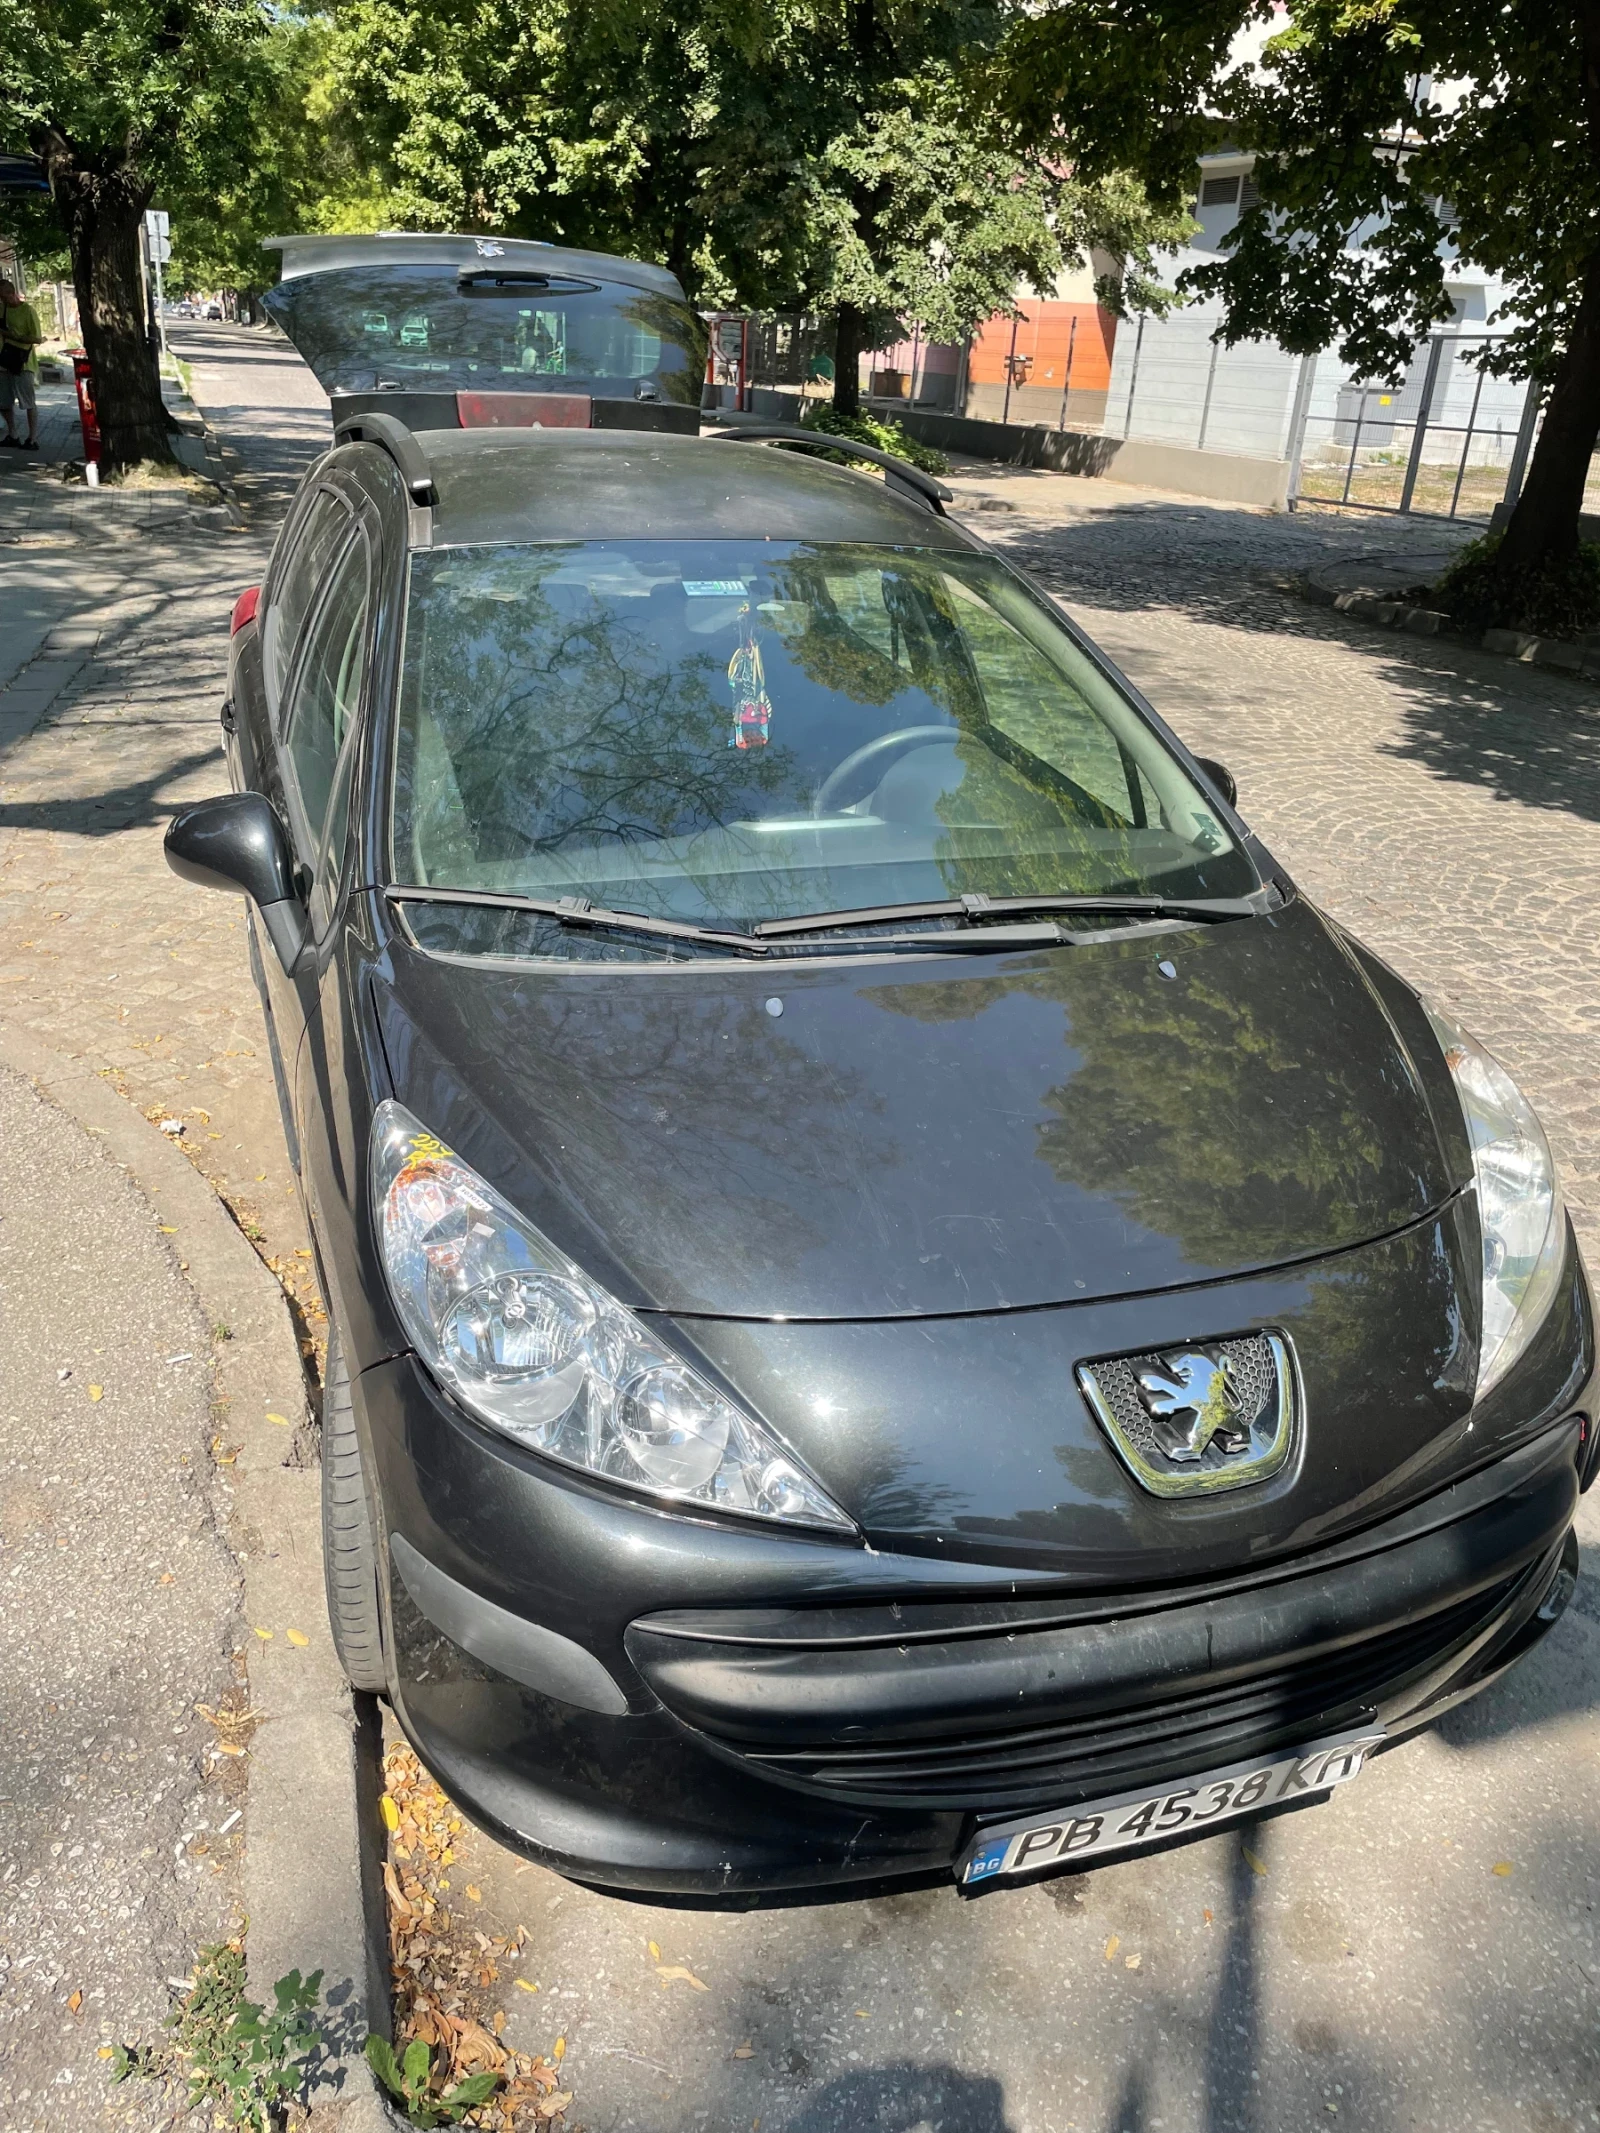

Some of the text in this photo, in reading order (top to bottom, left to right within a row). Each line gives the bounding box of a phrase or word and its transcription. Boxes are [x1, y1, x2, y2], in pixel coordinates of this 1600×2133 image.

[1010, 1814, 1104, 1866] PB
[1116, 1770, 1273, 1837] 4538
[973, 1858, 1000, 1875] BG
